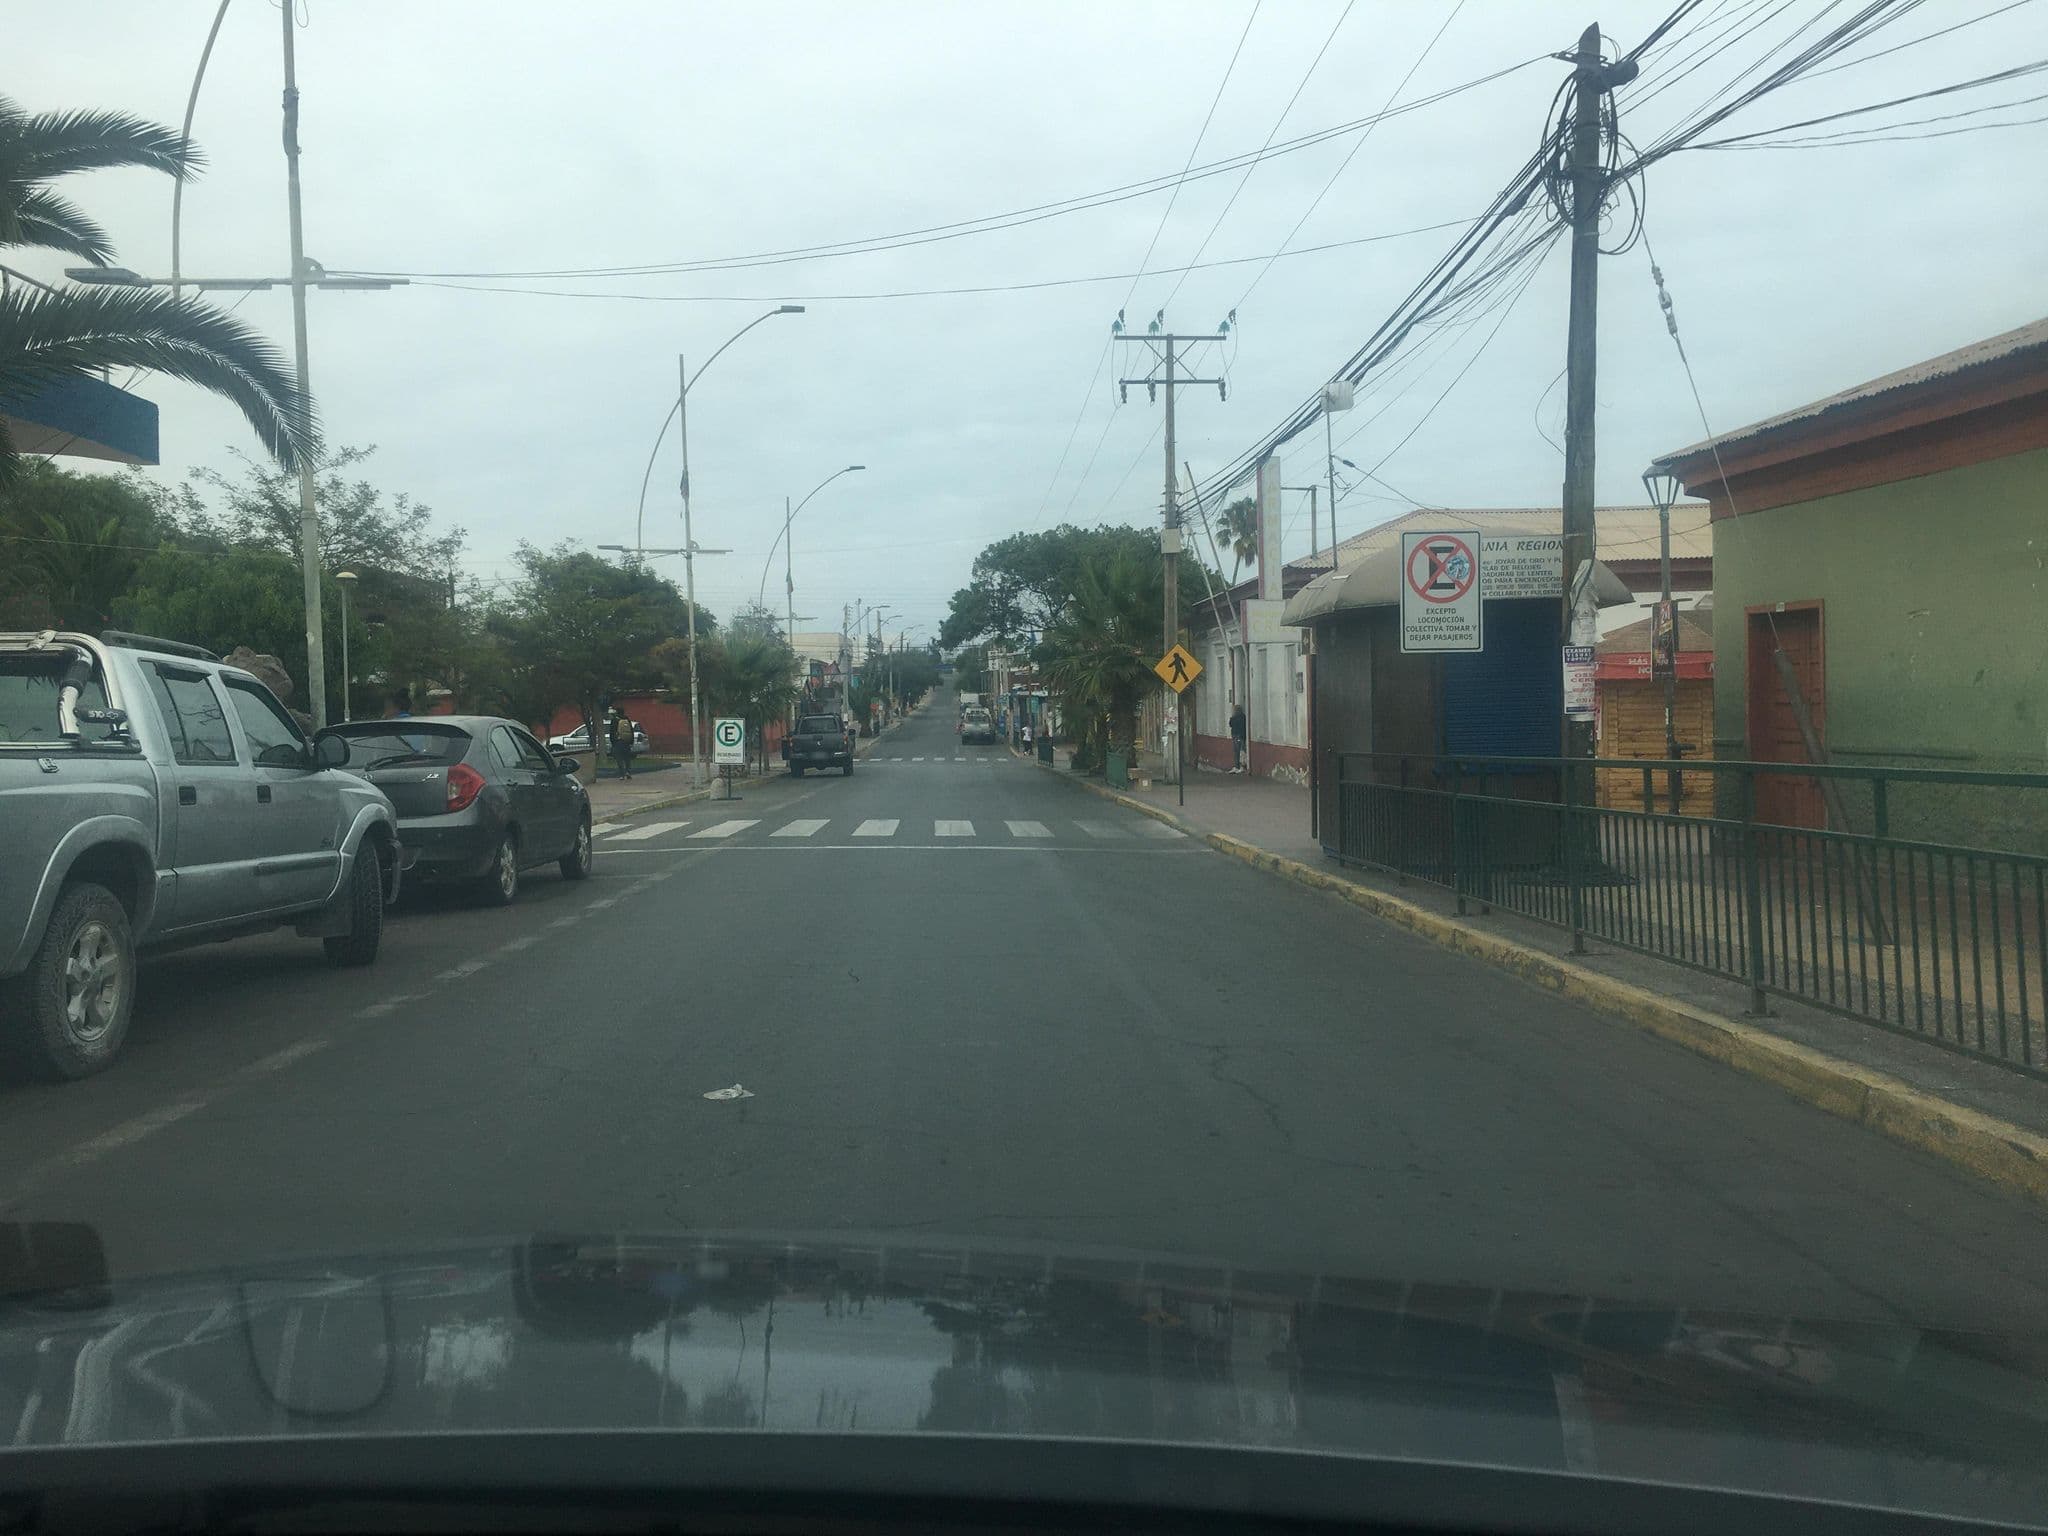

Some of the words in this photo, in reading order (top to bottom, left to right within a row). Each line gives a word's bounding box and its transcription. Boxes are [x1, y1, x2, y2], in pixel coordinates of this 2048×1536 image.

[1417, 615, 1465, 624] LOCOMOCIÓN
[1472, 624, 1478, 632] Y
[1409, 634, 1431, 642] DEJAR
[1433, 633, 1473, 641] PASAJEROS
[724, 726, 736, 742] E
